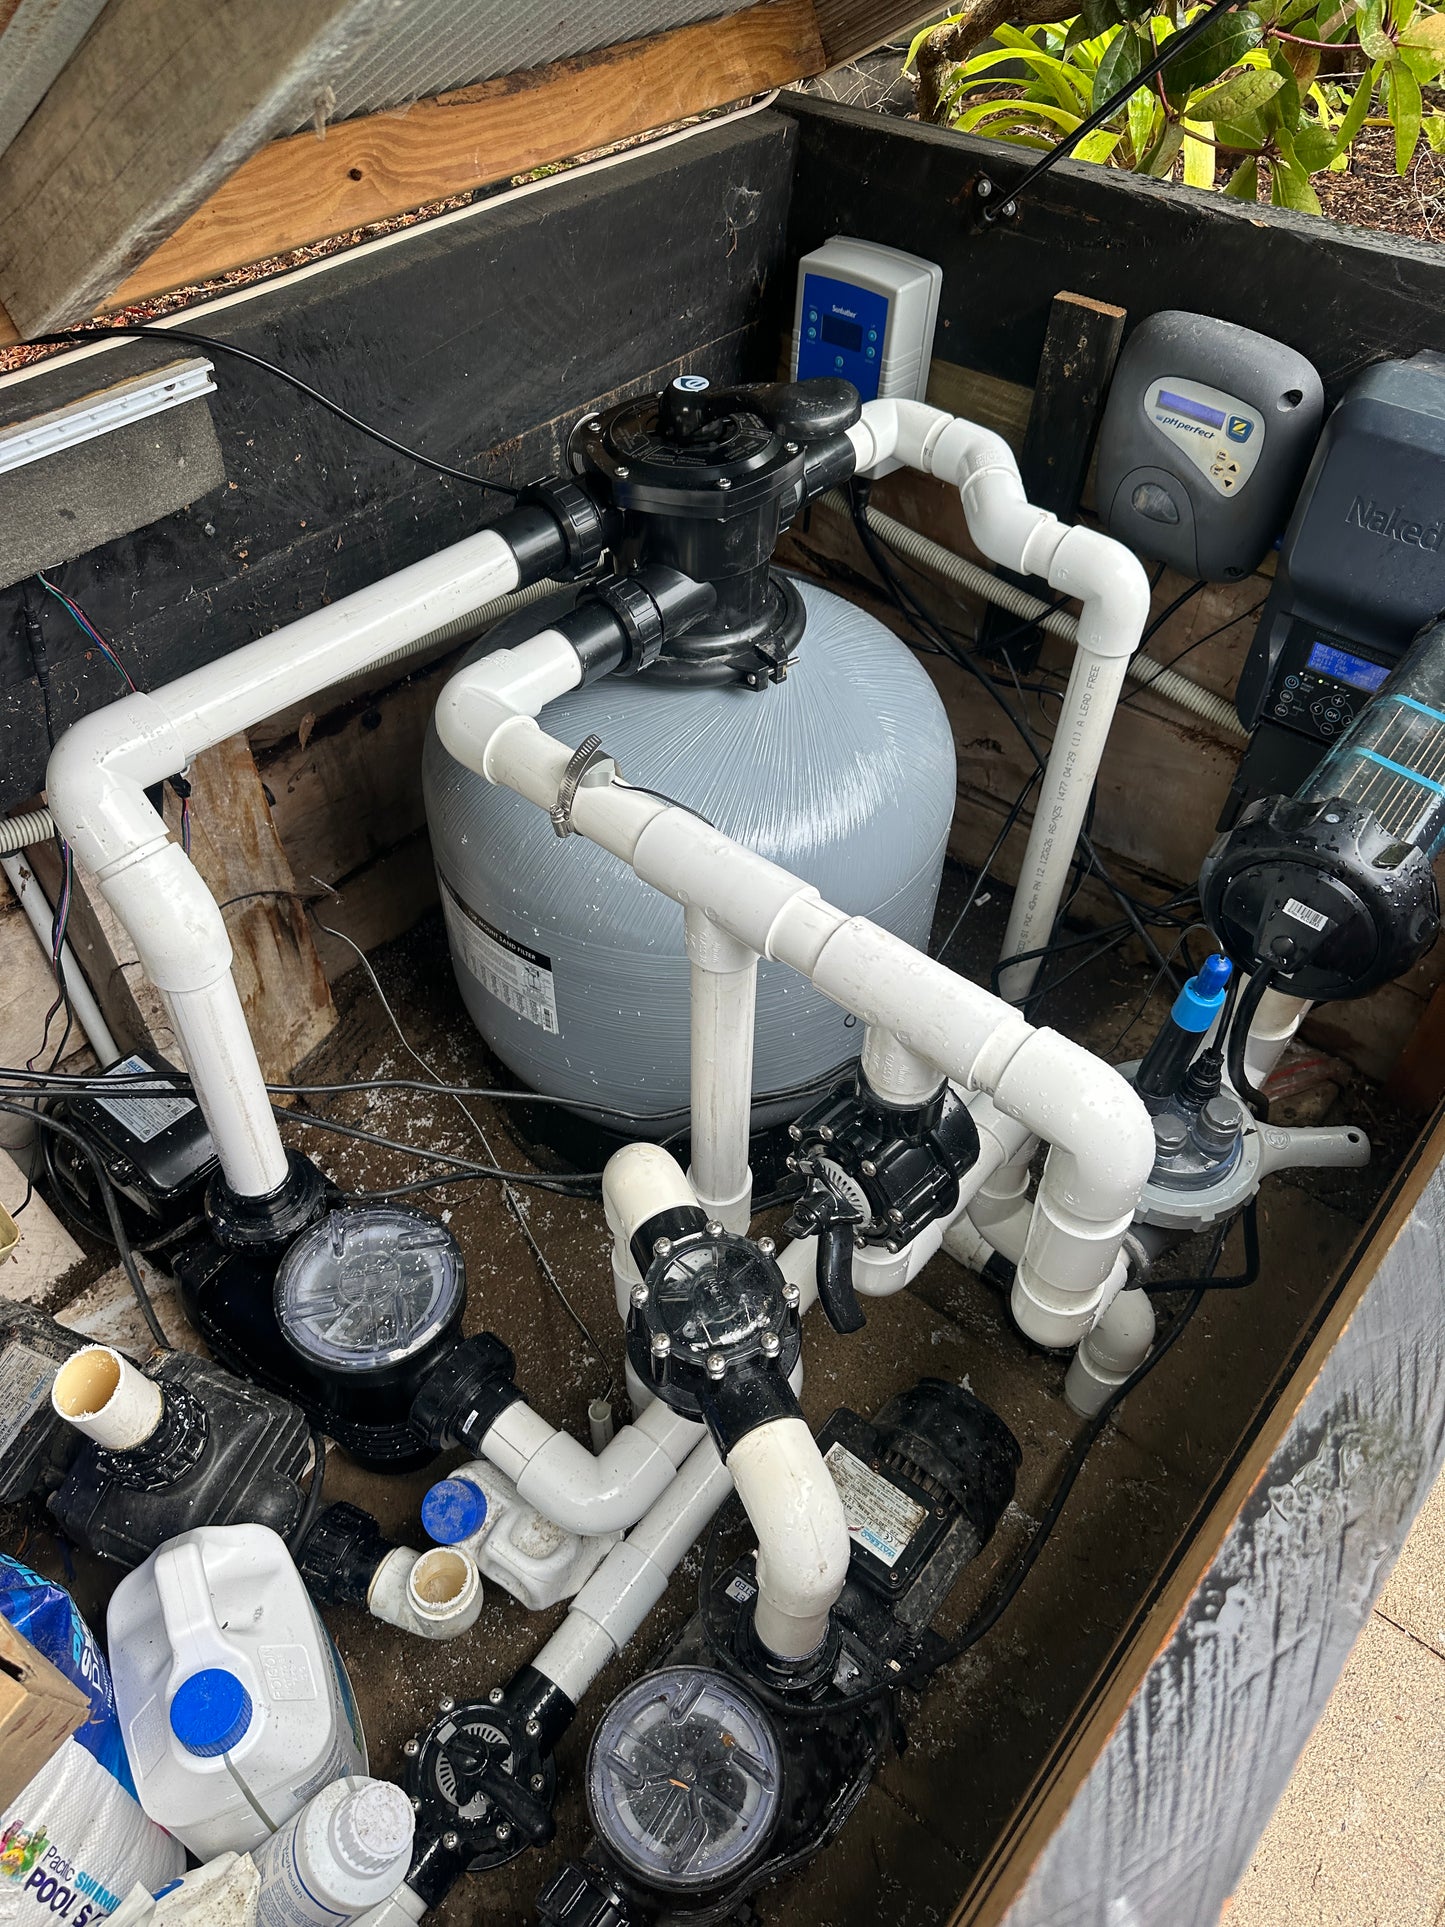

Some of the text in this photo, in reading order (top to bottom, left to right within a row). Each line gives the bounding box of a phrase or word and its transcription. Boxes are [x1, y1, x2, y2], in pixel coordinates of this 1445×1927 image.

[1345, 495, 1445, 553] Naked
[1086, 664, 1100, 689] FREE
[1079, 693, 1092, 716] LEAD
[1327, 710, 1338, 719] OK
[1062, 751, 1077, 778] 04:29
[1056, 781, 1069, 802] 1477
[1048, 805, 1064, 835] AS/NZS
[1035, 867, 1045, 878] 12
[1023, 913, 1033, 927] PVC
[499, 936, 517, 950] SAND
[517, 946, 536, 961] FILTER
[860, 1530, 895, 1559] WATERCO
[733, 1591, 746, 1603] ET
[734, 1580, 755, 1597] STED
